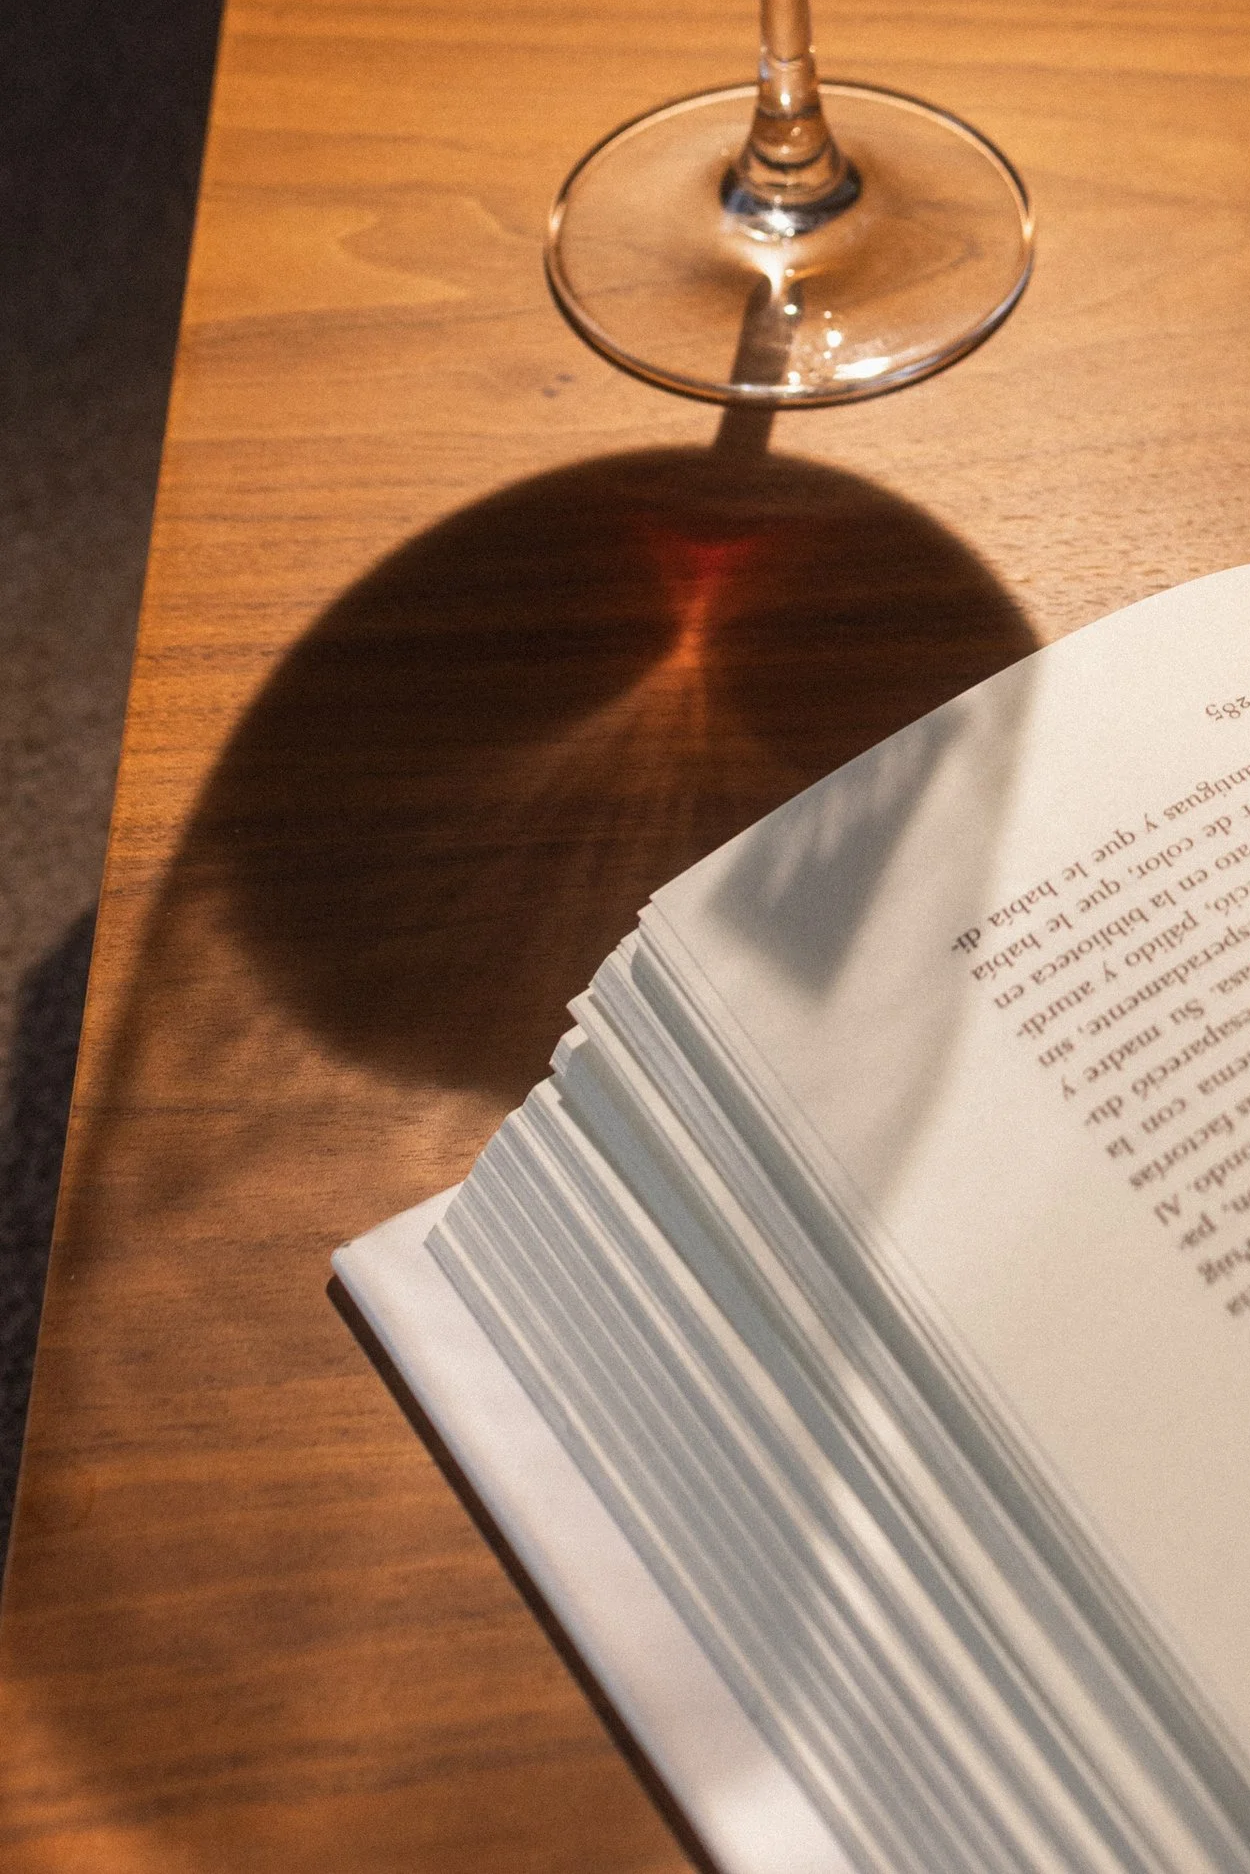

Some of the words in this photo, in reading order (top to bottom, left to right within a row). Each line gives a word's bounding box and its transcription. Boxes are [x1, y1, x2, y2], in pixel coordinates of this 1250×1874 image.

[1205, 695, 1250, 721] 285
[1143, 812, 1160, 834] y
[1202, 815, 1233, 838] de
[1094, 829, 1136, 863] que
[1061, 861, 1089, 882] le
[1177, 869, 1209, 892] en
[986, 880, 1059, 928] había
[1076, 878, 1121, 914] que
[1148, 889, 1177, 909] la
[1046, 912, 1074, 933] le
[1029, 907, 1150, 986] biblioteca
[1124, 909, 1200, 968] pálido
[970, 932, 1042, 982] había
[1102, 961, 1119, 984] y
[993, 983, 1026, 1010] en
[1037, 1037, 1075, 1069] sin
